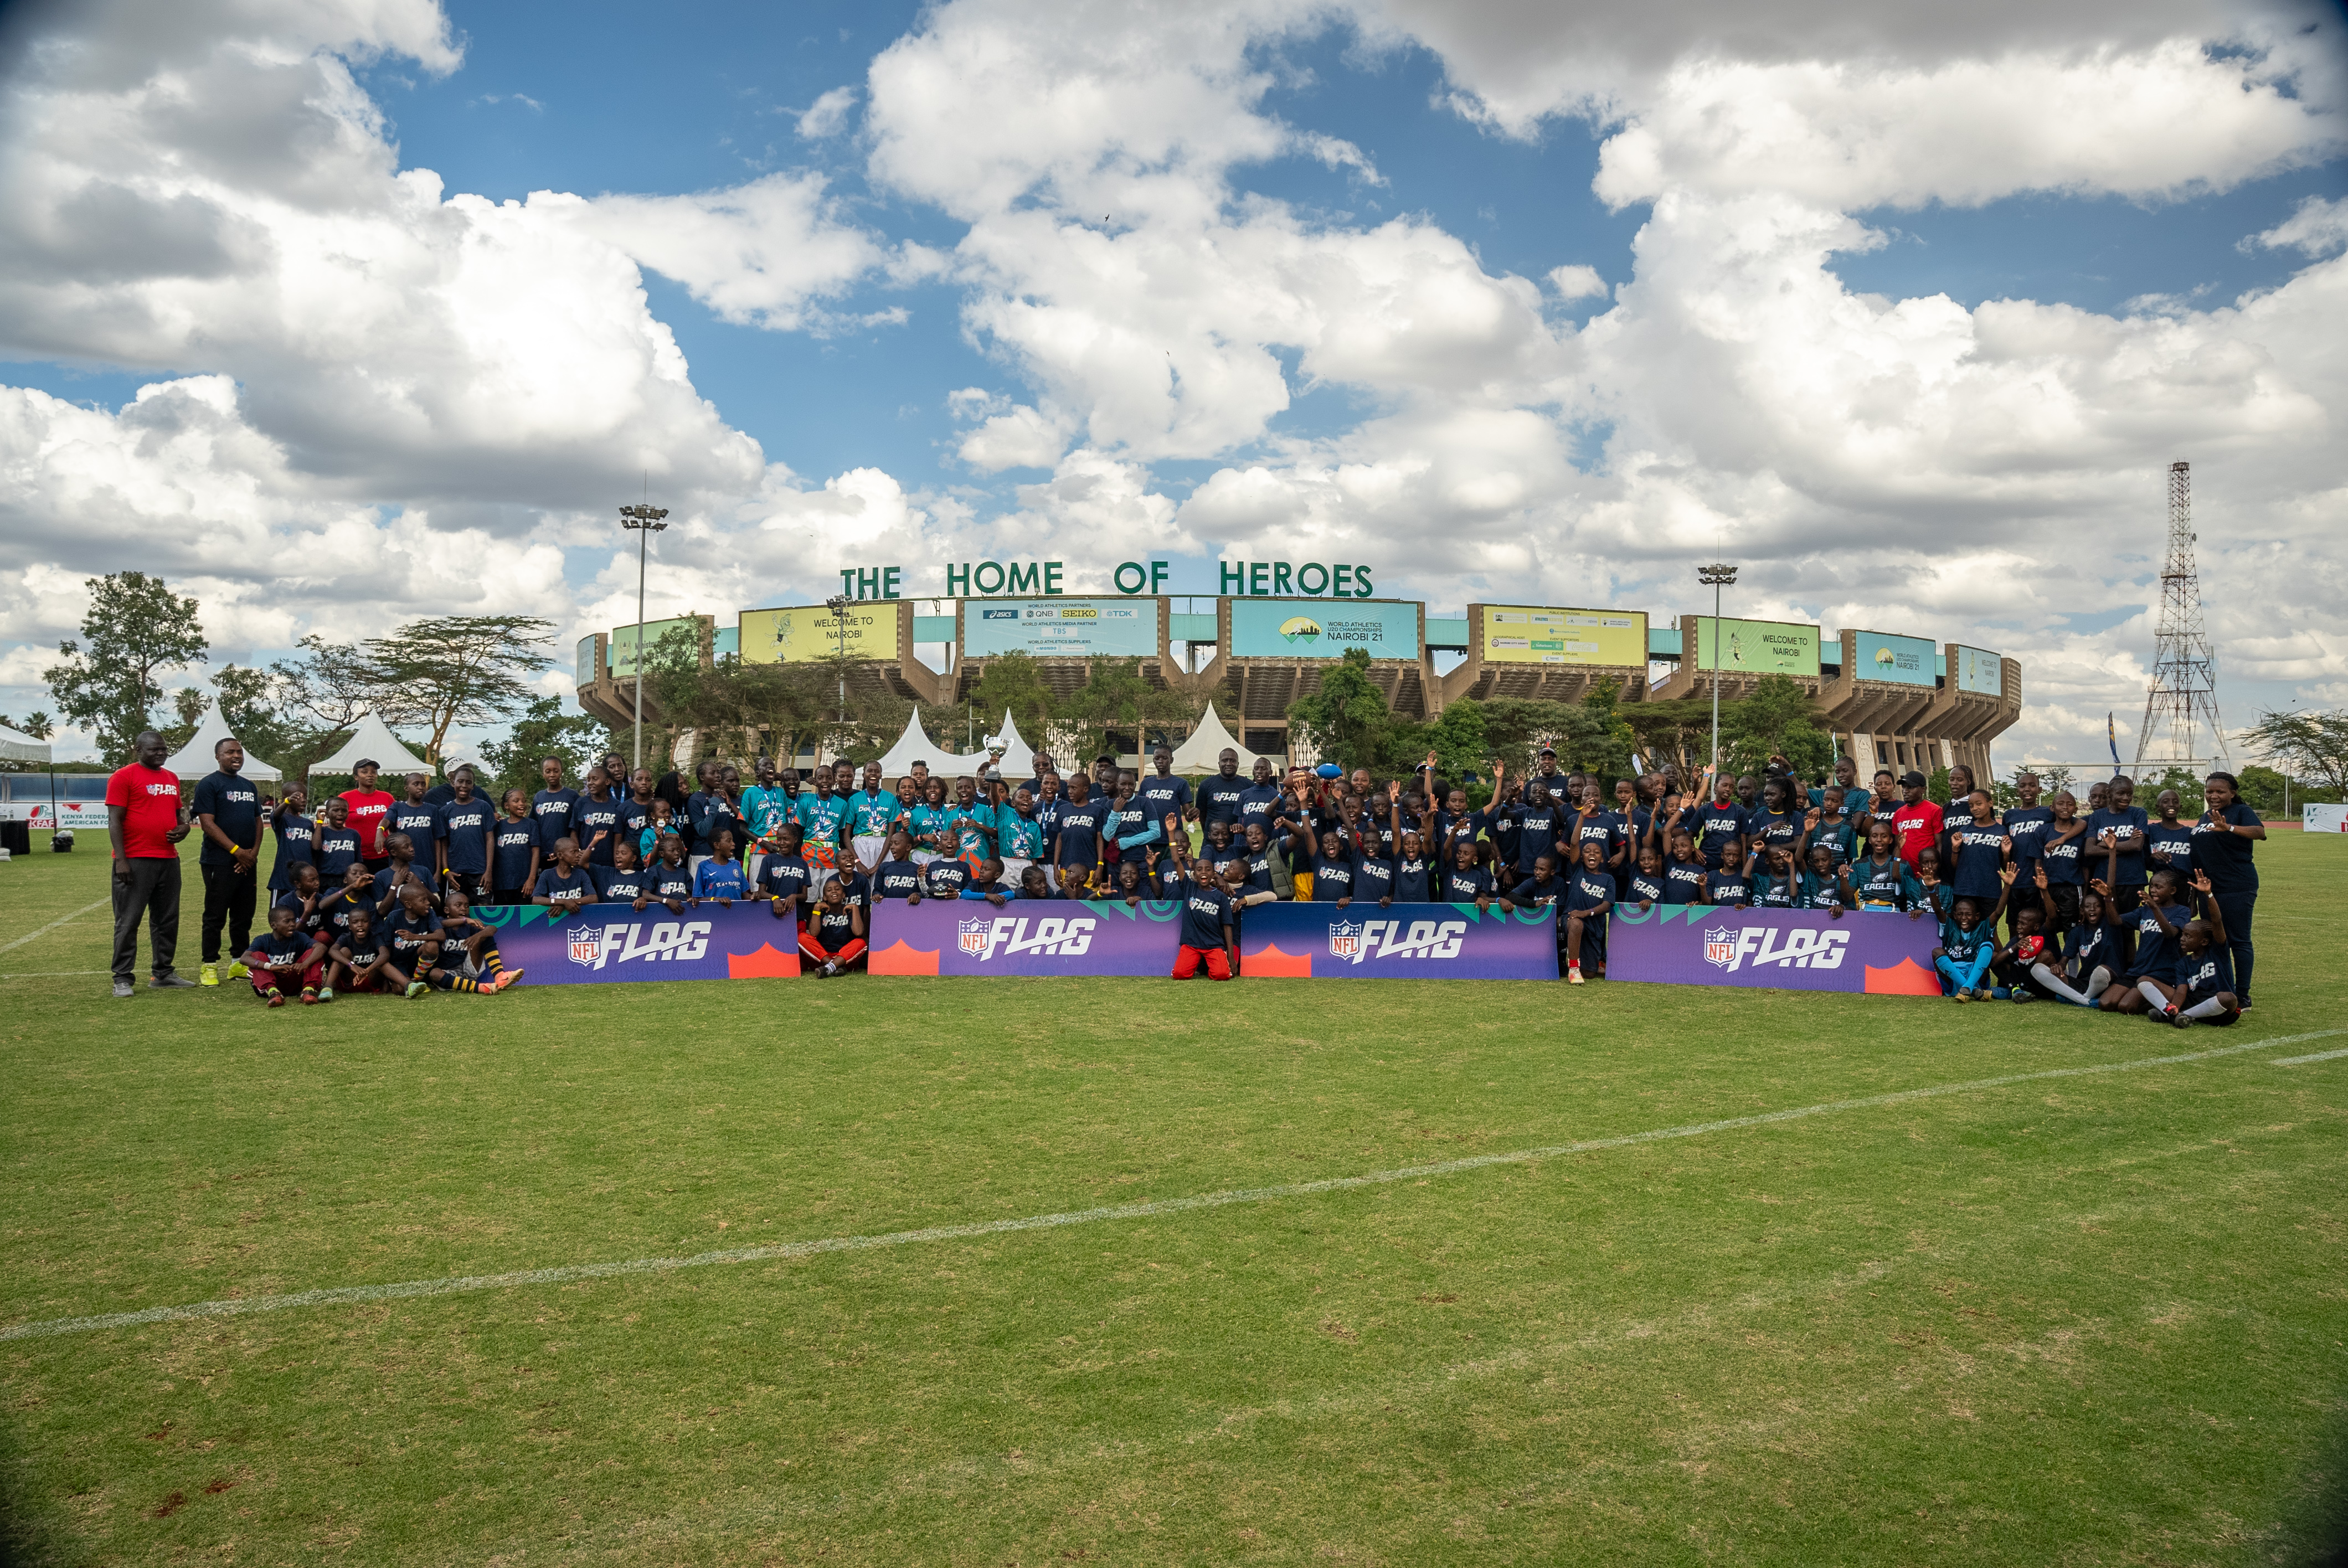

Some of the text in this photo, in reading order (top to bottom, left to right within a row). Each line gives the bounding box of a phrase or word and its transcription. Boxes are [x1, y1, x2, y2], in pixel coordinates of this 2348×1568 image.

[840, 561, 1373, 599] THE HOME OF HEROES
[814, 616, 873, 627] WELCOME TO
[826, 630, 862, 639] NAIROBI
[1327, 632, 1383, 641] NAIROBI 21
[1763, 635, 1808, 646] WELCOME TO
[1773, 647, 1800, 657] NAIROBI
[1897, 661, 1914, 669] NAIROBI
[154, 783, 177, 796] FLAG
[1149, 790, 1174, 800] FLAG
[1549, 788, 1563, 797] AG
[233, 791, 254, 802] FLAG
[363, 804, 388, 816] FLAG
[541, 802, 569, 816] FLAG
[400, 816, 431, 829] FLAG
[454, 814, 482, 830] FLAG
[591, 812, 616, 826] FLAG
[635, 816, 647, 830] FL
[1068, 816, 1094, 828] FLAG
[1120, 811, 1143, 822] FLAG
[1946, 816, 1973, 829] FLAG
[1527, 819, 1551, 831] FLAG
[1709, 819, 1736, 831] FLAG
[1901, 819, 1924, 831] FLAG
[2014, 820, 2044, 837] FLAG
[291, 827, 312, 840] FLA
[1579, 827, 1608, 840] FLAG
[1968, 833, 2002, 847] FLAG
[329, 840, 355, 853] FLAG
[502, 833, 529, 848] FLAG
[2051, 845, 2078, 859] LAG
[2159, 841, 2190, 855] FLAG
[779, 866, 805, 879] FLAG
[936, 869, 964, 883] FLAG
[1323, 868, 1350, 883] FLAG
[1367, 865, 1390, 880] FLAG
[1673, 869, 1698, 884] FLAG
[888, 875, 916, 888] FLAG
[1453, 876, 1476, 894] FLAG
[556, 887, 581, 900] FLAG
[612, 884, 639, 898] FLAG
[1583, 883, 1606, 899] FLAG
[1635, 880, 1660, 899] FLAG
[1719, 885, 1745, 900] FLAG
[1191, 898, 1219, 916] FLAG
[827, 915, 849, 927] FLAG
[2142, 919, 2163, 933] FLA
[572, 921, 712, 971] NFL FLAG
[962, 917, 1096, 962] NFL FLAG
[1333, 920, 1467, 965] NFL FLAG
[1708, 927, 1851, 973] NFL FLAG
